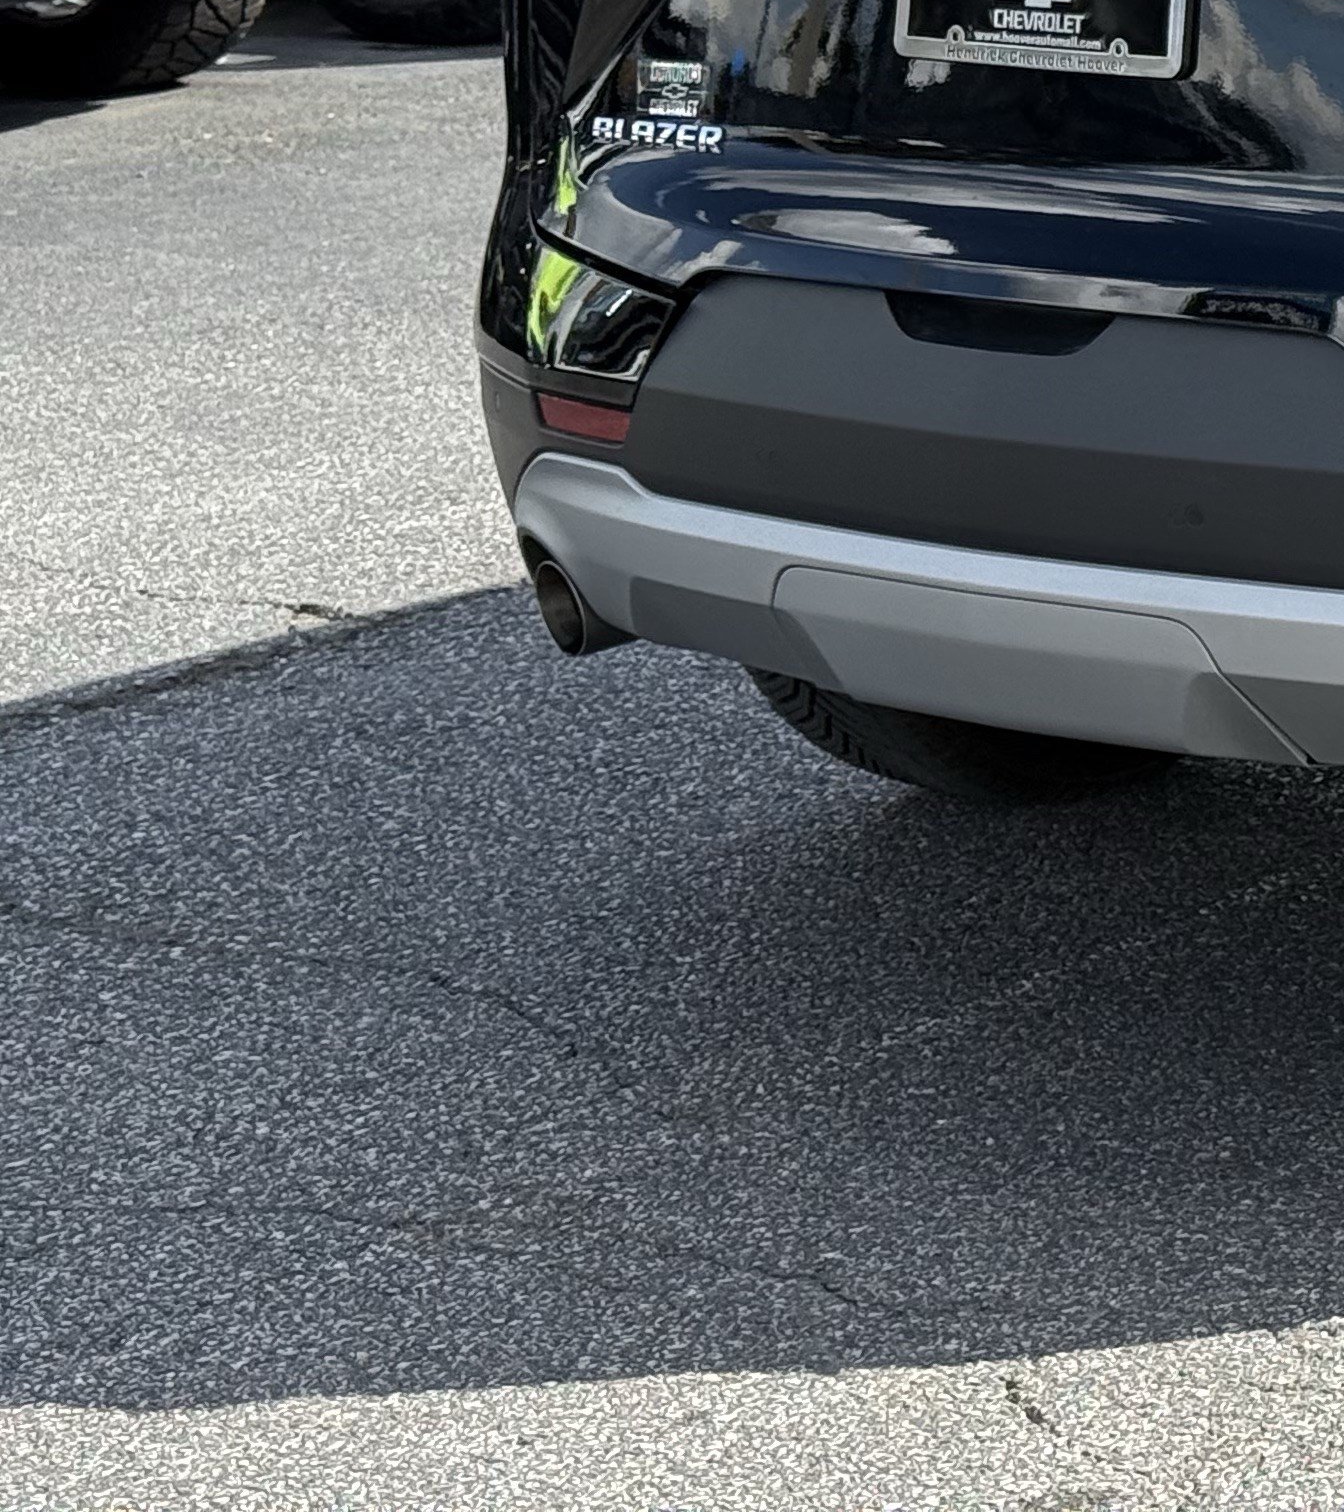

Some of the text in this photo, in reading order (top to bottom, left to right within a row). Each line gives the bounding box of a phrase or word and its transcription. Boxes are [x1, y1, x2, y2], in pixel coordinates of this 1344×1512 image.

[993, 9, 1086, 33] CHEVROLET
[945, 44, 1126, 72] Hendrick Chevrolet Hoover
[592, 117, 723, 154] BLAZER
